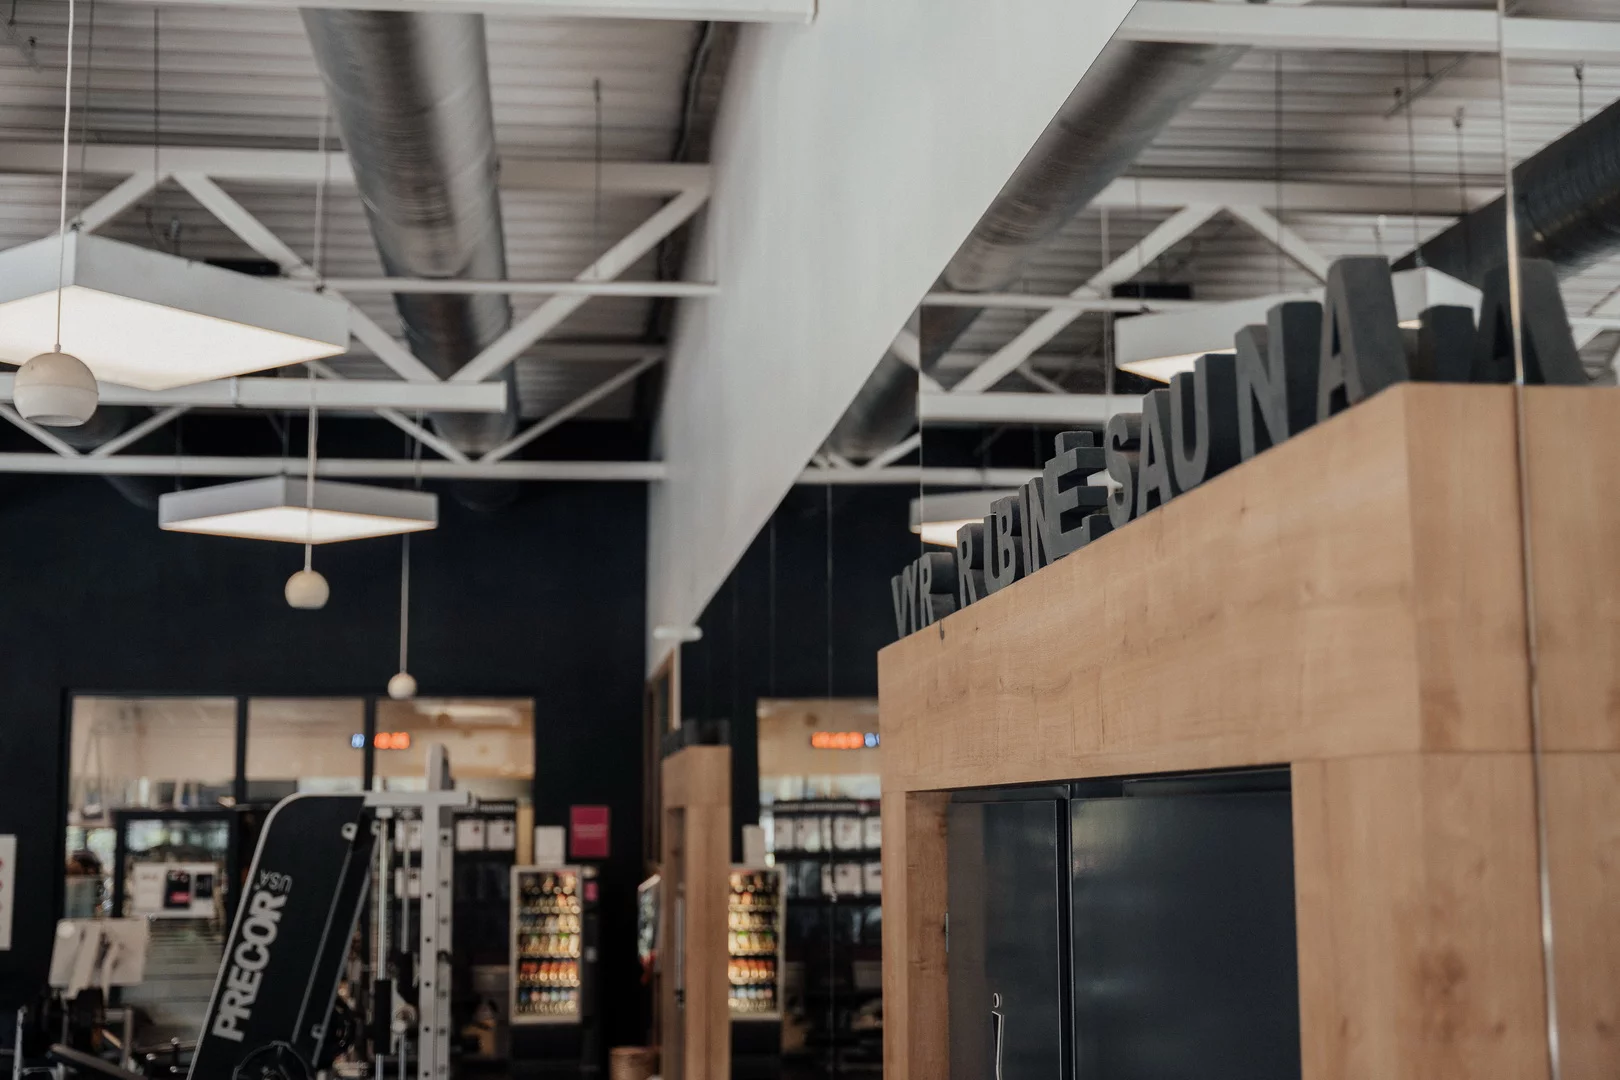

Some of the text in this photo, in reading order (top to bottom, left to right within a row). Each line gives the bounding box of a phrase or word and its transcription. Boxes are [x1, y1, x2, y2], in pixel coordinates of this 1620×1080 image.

[1104, 255, 1400, 532] SAUNA
[260, 869, 293, 893] USA
[212, 890, 288, 1043] PRECOR
